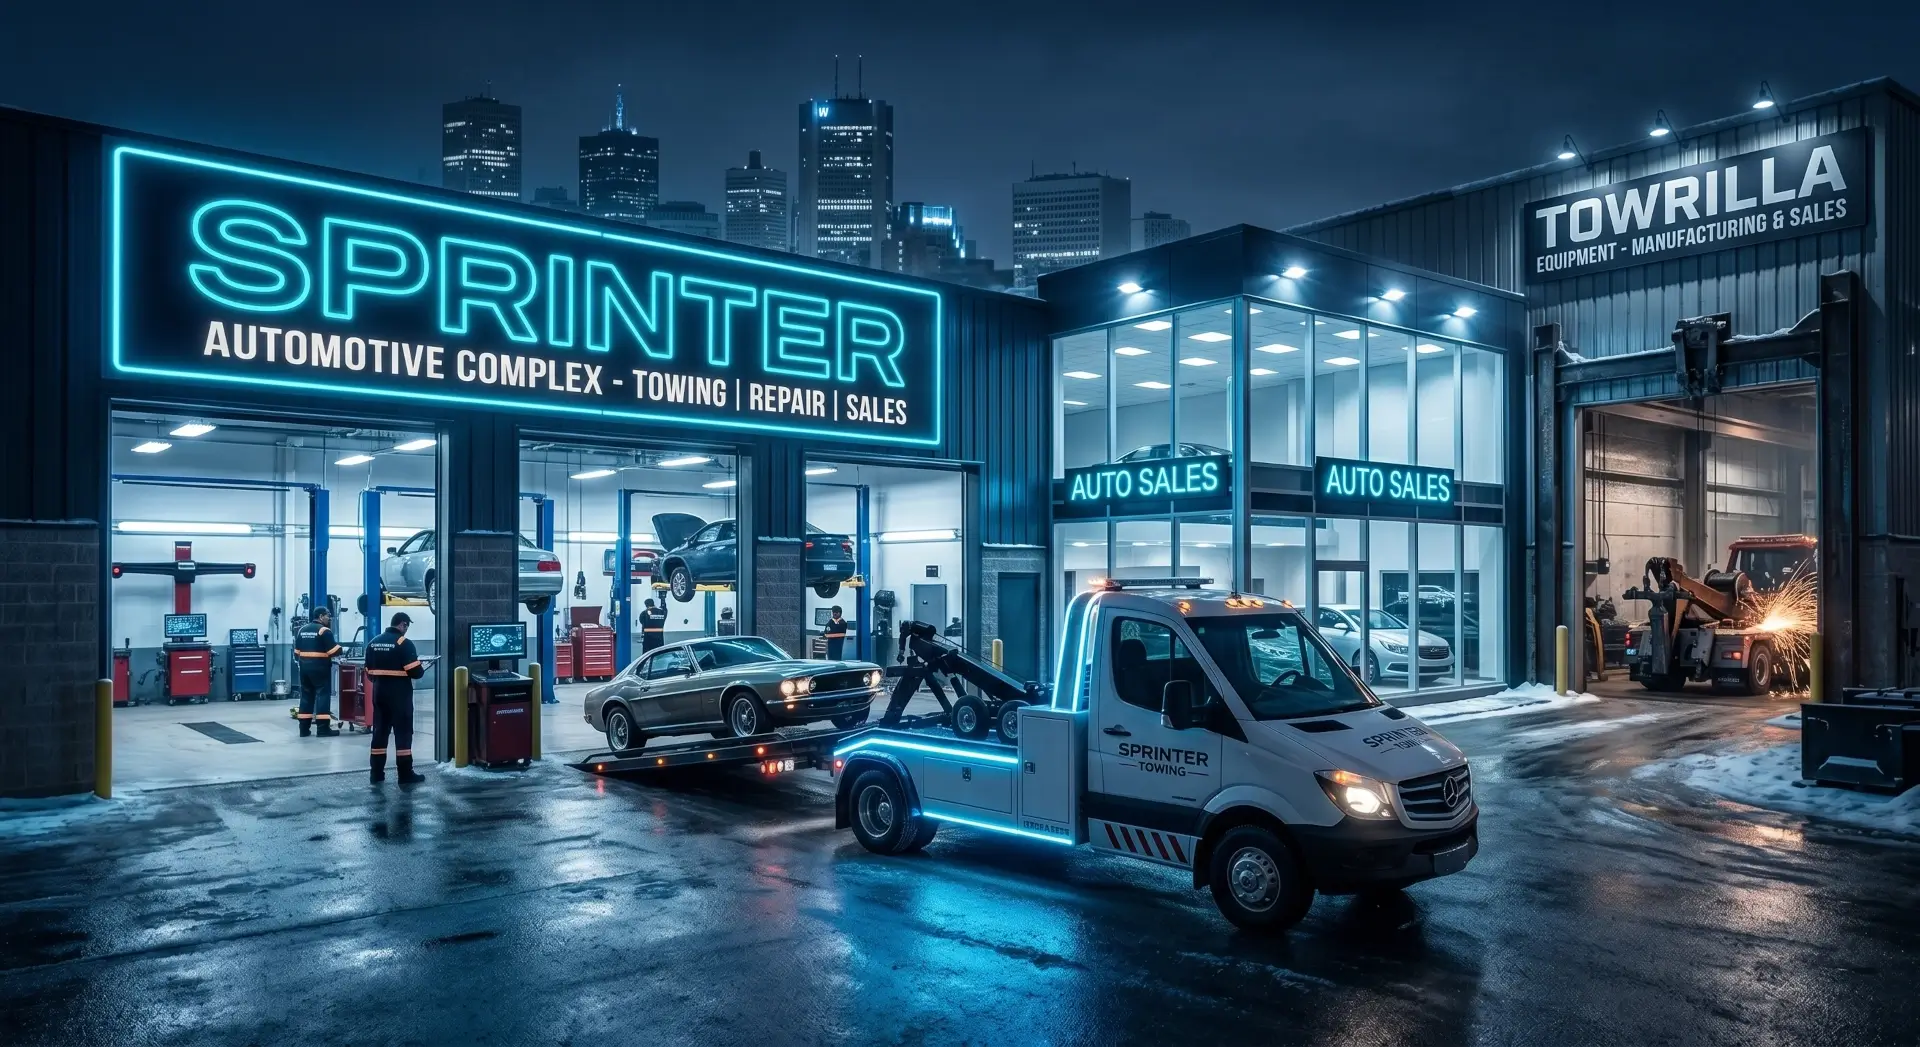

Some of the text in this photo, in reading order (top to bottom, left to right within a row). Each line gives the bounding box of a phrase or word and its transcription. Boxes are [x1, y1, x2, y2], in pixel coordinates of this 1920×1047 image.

[819, 107, 829, 117] W
[1536, 145, 1847, 249] TOWRILLA
[1536, 242, 1617, 273] EQUIPMENT
[1632, 213, 1767, 256] MANUFACTURING
[1773, 209, 1785, 231] &
[1790, 197, 1847, 227] SALES
[189, 199, 905, 387] SPRINTER
[203, 320, 445, 379] AUTOMOTIVE
[456, 349, 603, 395] COMPLEX
[632, 369, 727, 407] TOWING
[750, 382, 826, 417] REPAIR
[846, 394, 907, 425] SALES
[1071, 462, 1218, 500] AUTO SALES
[1326, 465, 1450, 501] AUTO SALES
[1118, 742, 1209, 767] SPRINTER
[1138, 761, 1186, 777] TOWING
